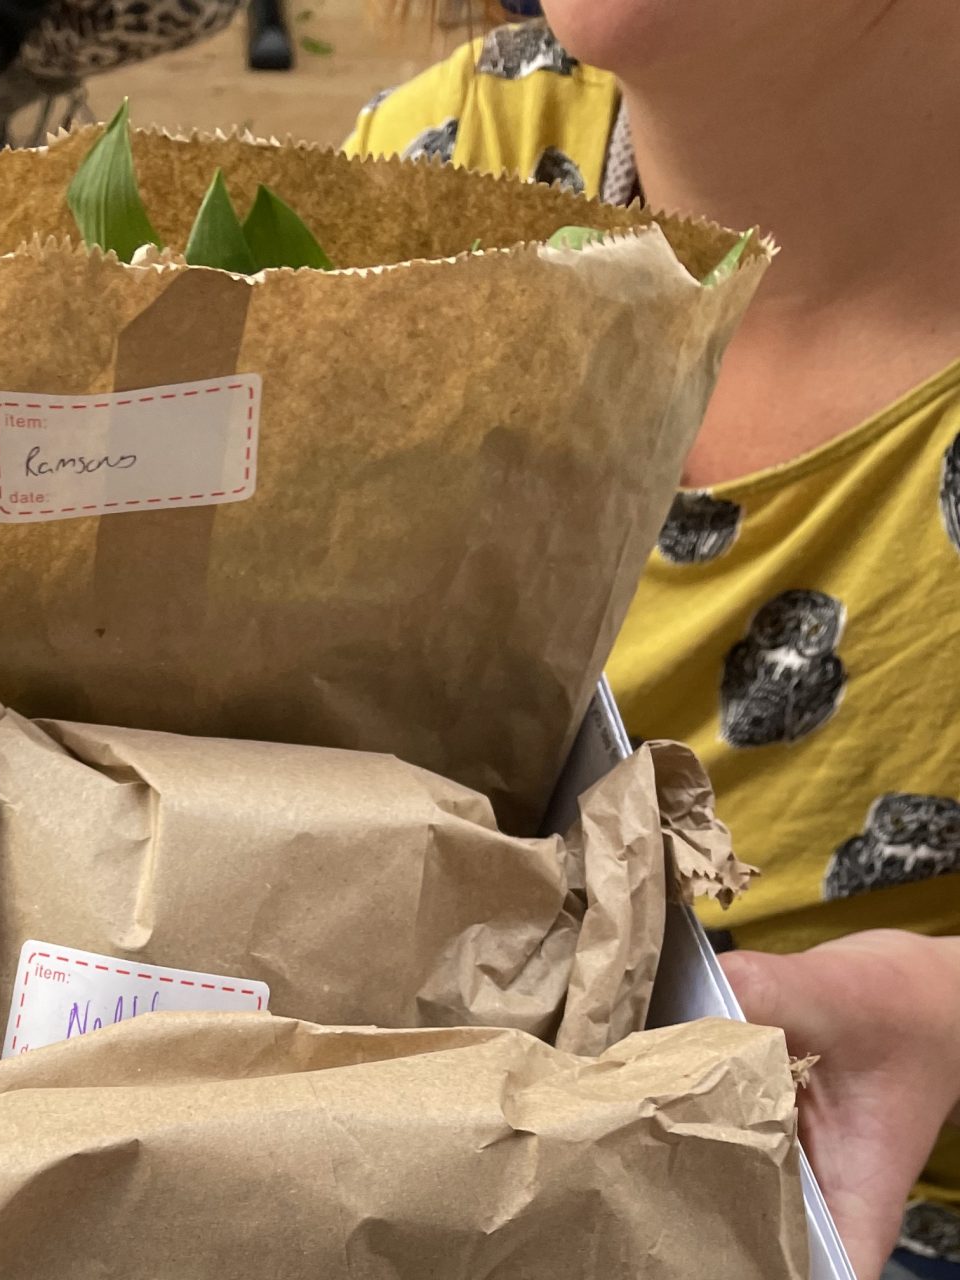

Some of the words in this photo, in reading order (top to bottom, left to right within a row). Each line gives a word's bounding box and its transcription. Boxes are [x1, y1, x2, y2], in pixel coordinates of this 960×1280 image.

[4, 413, 48, 429] item:
[9, 490, 50, 504] date:
[35, 963, 71, 984] item:
